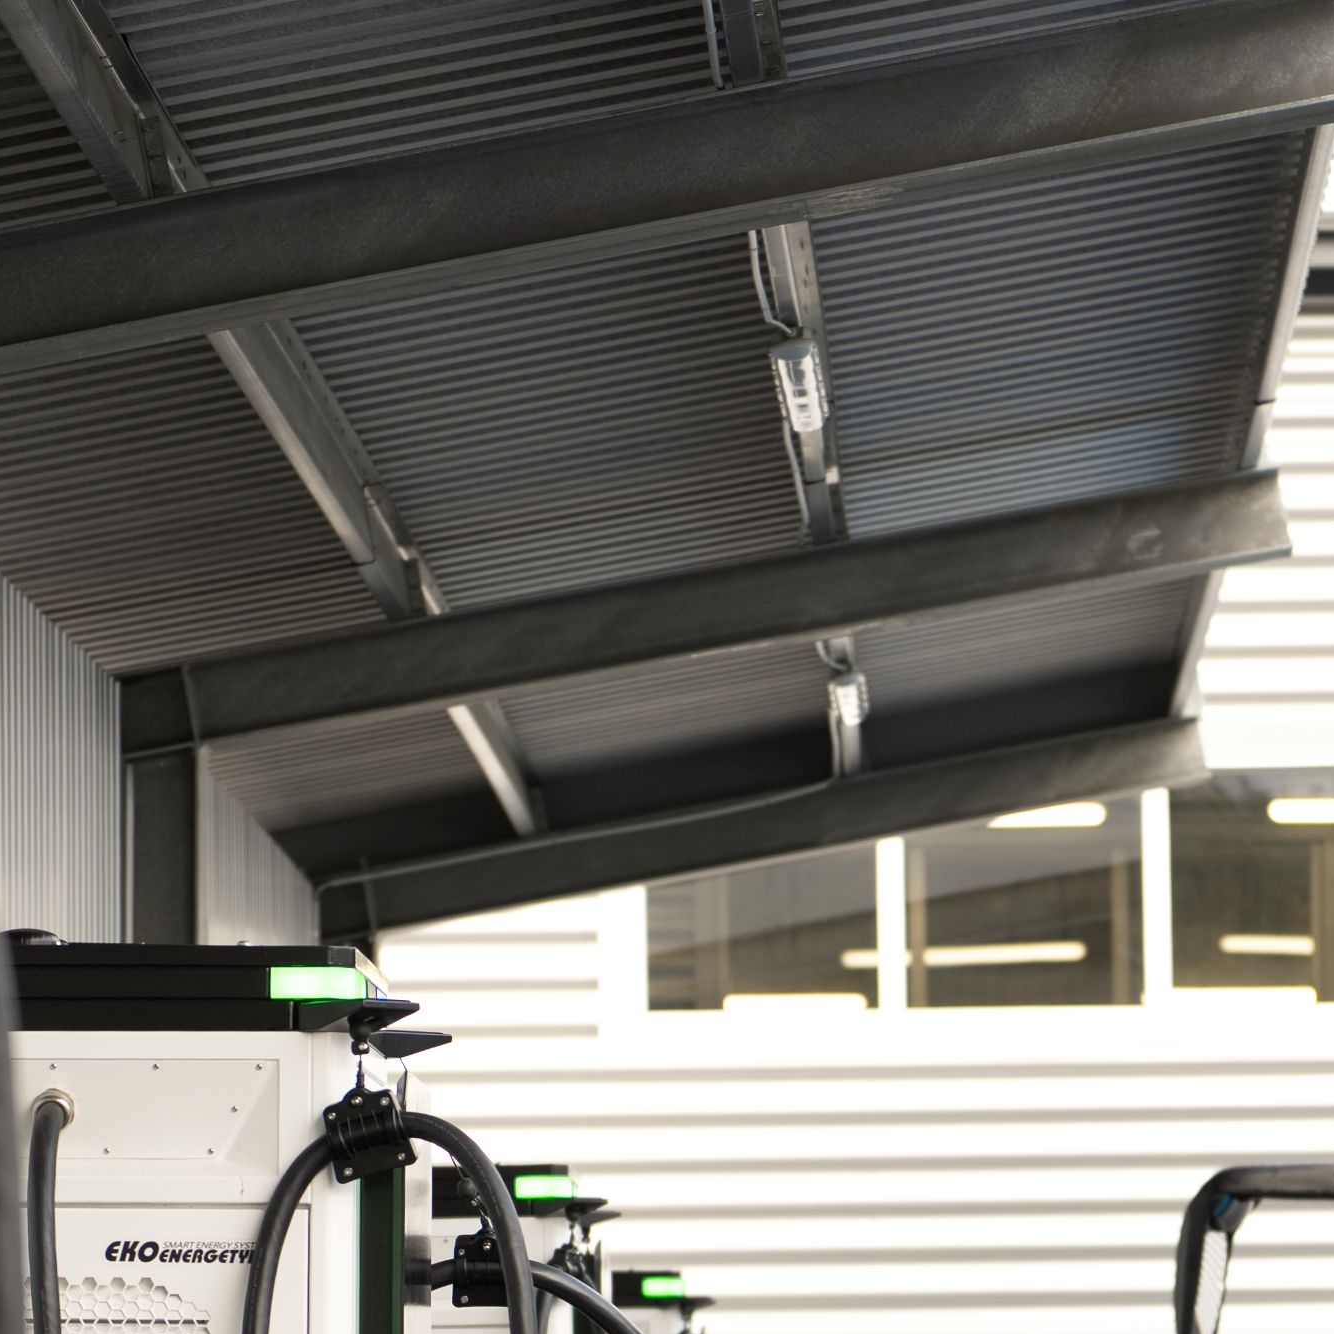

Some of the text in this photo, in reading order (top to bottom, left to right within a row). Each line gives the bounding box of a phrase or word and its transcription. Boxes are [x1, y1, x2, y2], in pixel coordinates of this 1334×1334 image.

[105, 1241, 253, 1263] EKO ENERGETY
[163, 1241, 257, 1249] SMART ENERGY SYST
